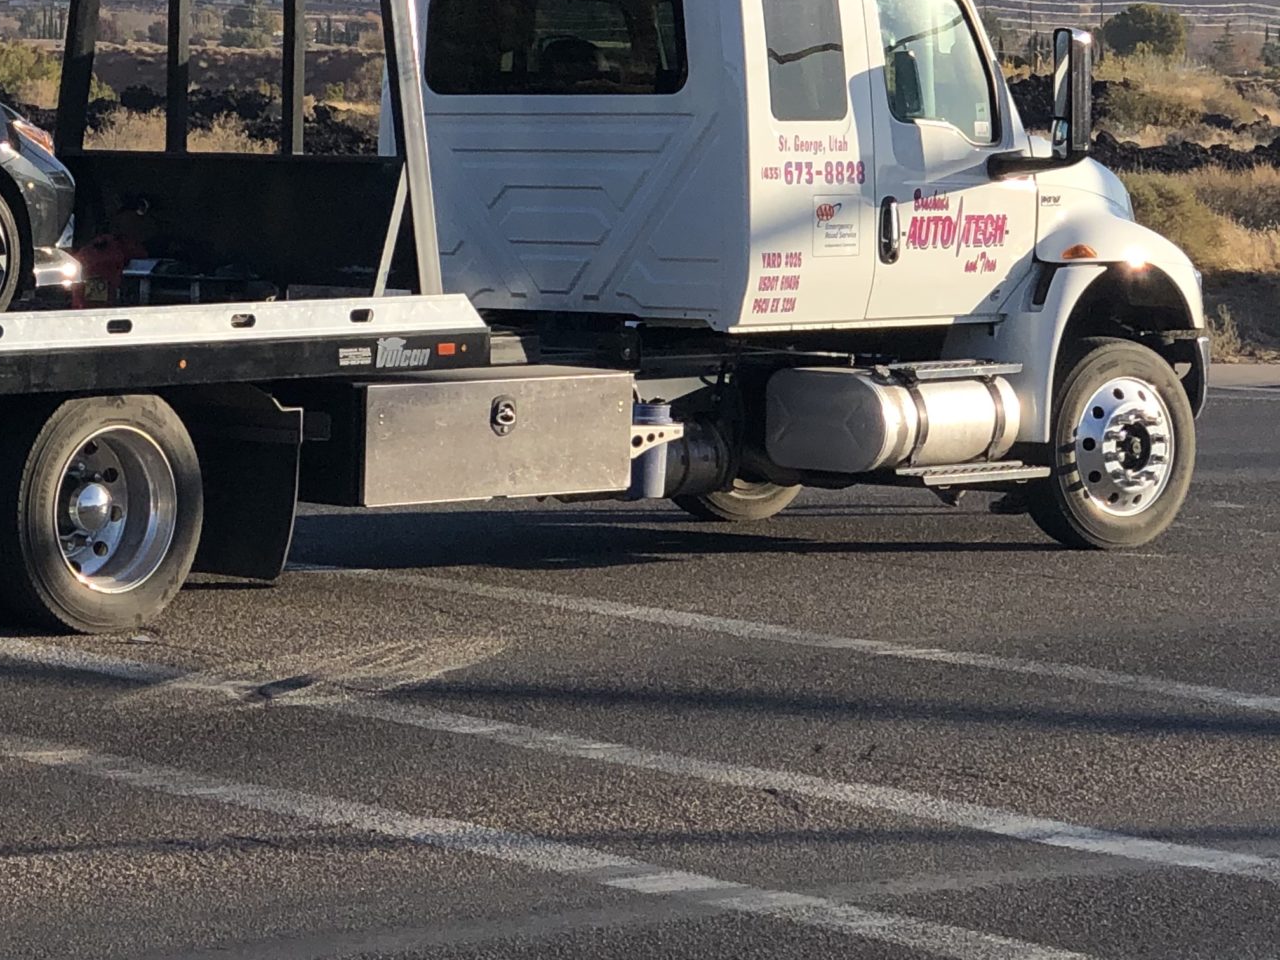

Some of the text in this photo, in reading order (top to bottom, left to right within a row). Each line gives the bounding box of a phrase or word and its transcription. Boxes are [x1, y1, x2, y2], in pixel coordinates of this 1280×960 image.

[778, 135, 848, 155] St. George, Utah
[761, 160, 866, 185] (435) 673-8828
[761, 252, 782, 269] YARD
[376, 341, 431, 369] Vulcan
